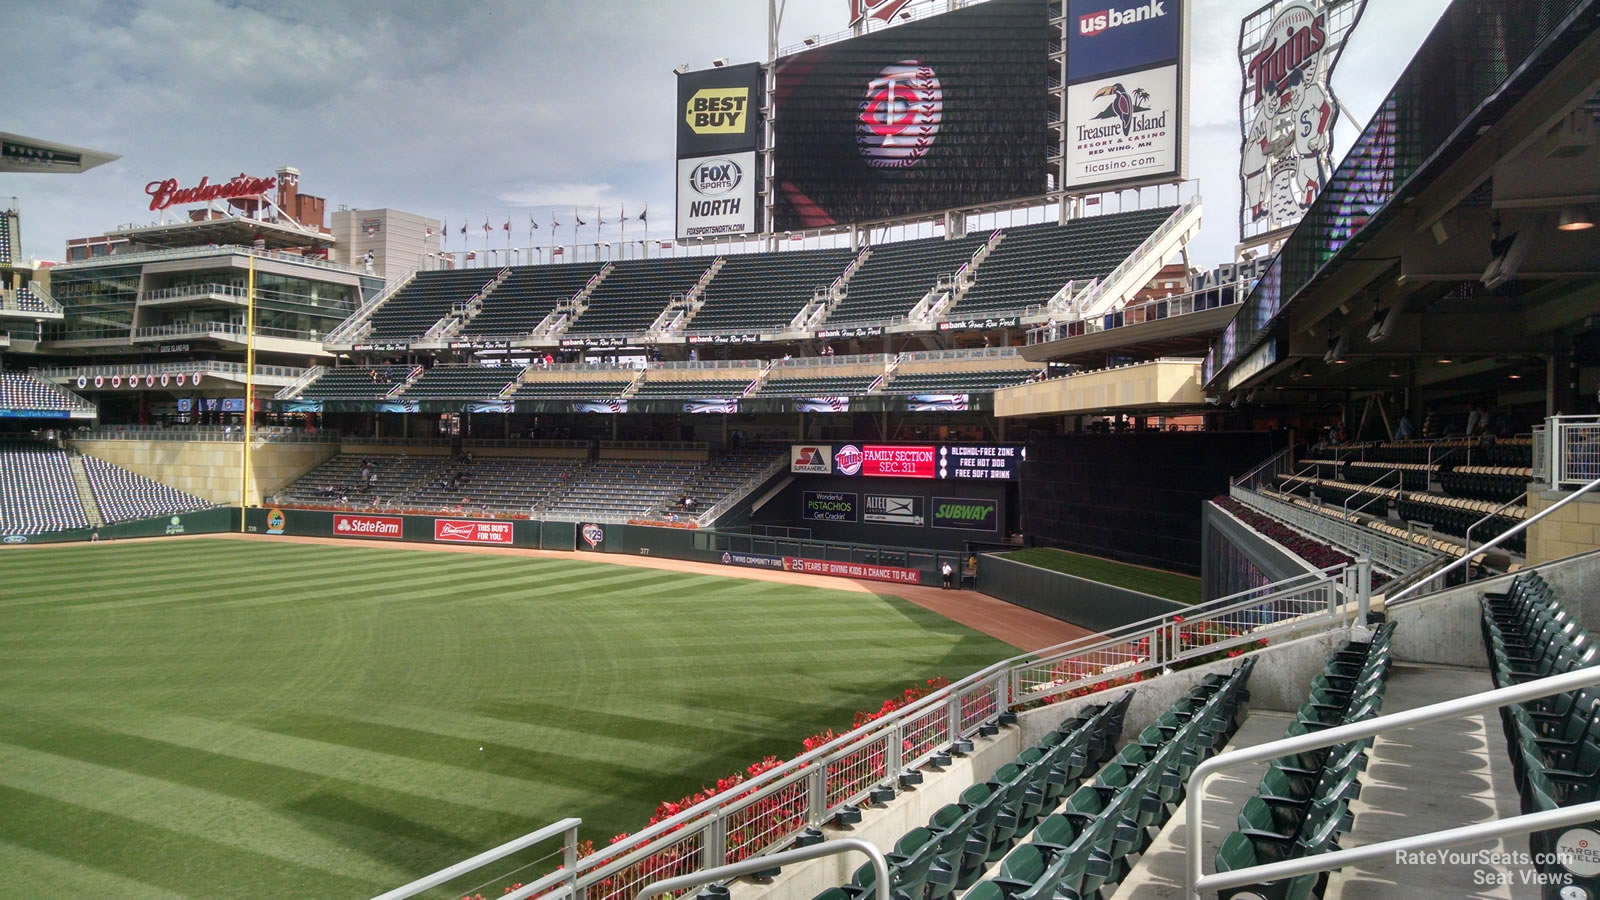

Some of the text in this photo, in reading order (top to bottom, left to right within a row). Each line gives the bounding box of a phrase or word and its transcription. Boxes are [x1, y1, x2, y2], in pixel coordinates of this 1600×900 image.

[1248, 12, 1325, 107] Twins
[694, 96, 746, 111] BEST
[694, 112, 741, 127] BUY
[1077, 111, 1166, 141] Treasure Island
[1078, 139, 1113, 150] RESORT
[1128, 131, 1166, 142] CASINO
[1085, 156, 1155, 173] ticasino.com
[700, 164, 730, 183] FOX
[700, 181, 732, 190] SPORTS
[145, 173, 277, 211] Budweiser
[689, 198, 741, 218] NORTH
[686, 223, 745, 236] FOXSPORTSNORTH.COM
[968, 320, 984, 329] Home
[986, 319, 998, 328] Run
[841, 329, 854, 337] Home
[855, 328, 866, 336] Run
[713, 335, 727, 343] Home
[729, 335, 739, 343] Run
[864, 450, 933, 462] FAMILY SECTION
[951, 447, 1014, 456] ALCOHOL-FREE ZONE
[835, 451, 863, 469] Twins
[977, 459, 990, 467] HOT
[992, 459, 1005, 467] DOG
[879, 462, 916, 473] SEC. 311
[955, 469, 1010, 478] FREE SOFT DRINK
[808, 501, 851, 512] PISTACHIOS
[866, 496, 886, 509] ALTEC
[825, 512, 845, 520] Crackin'
[935, 503, 993, 521] SUBWAY
[477, 524, 508, 532] THIS BUD'S
[477, 532, 488, 540] FOR
[592, 529, 602, 540] 29
[732, 555, 782, 567] TWINS COMMUNITY FUND
[792, 559, 917, 582] 25 YEARS OF GIVING KIDS A CHANCE TO PLAY.
